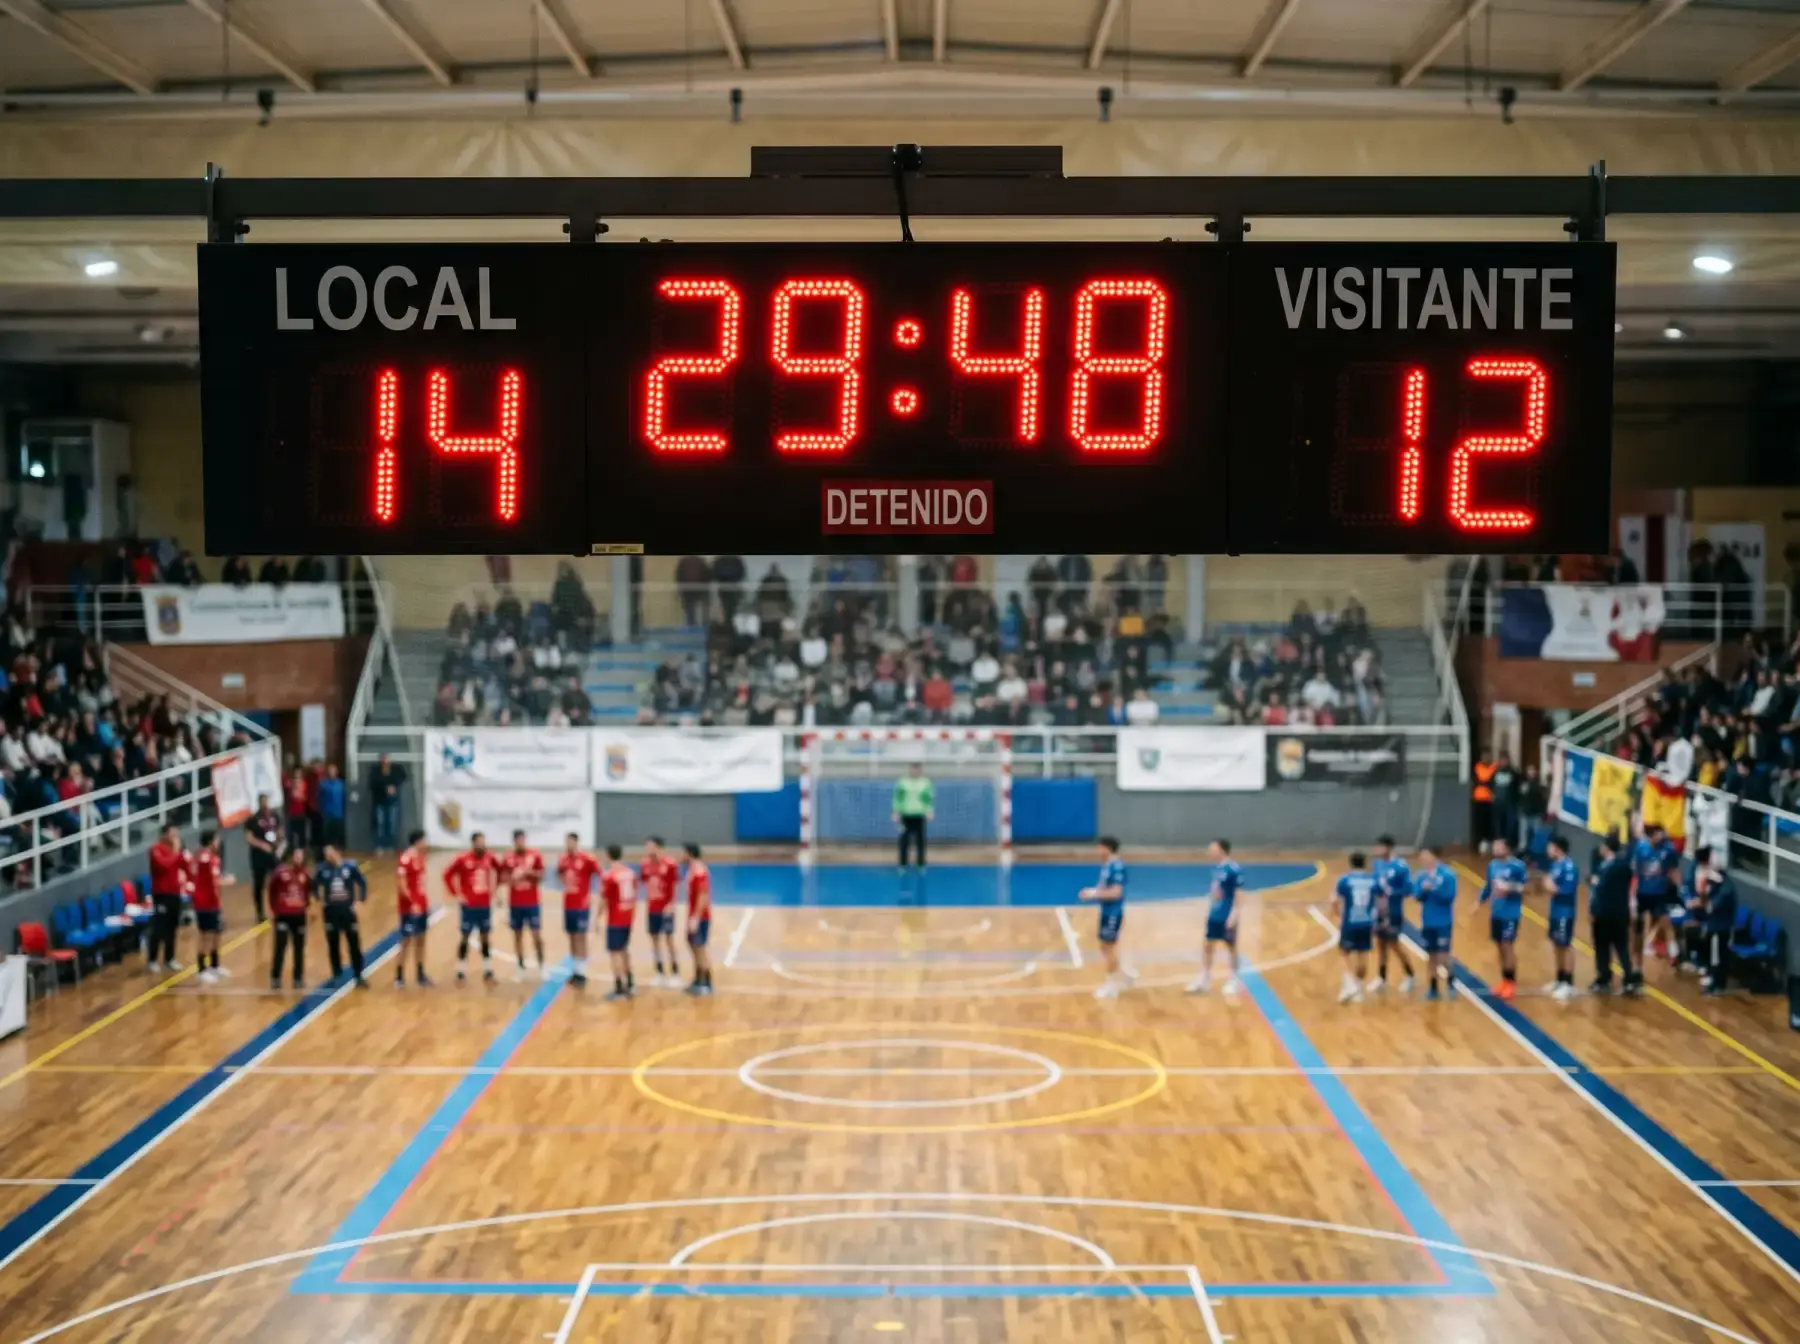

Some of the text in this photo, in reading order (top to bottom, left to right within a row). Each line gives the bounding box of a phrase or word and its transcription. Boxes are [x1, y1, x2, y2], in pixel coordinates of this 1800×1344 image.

[275, 265, 517, 331] LOCAL
[1274, 266, 1573, 330] VISITANTE
[643, 278, 1169, 453] 29:48
[374, 368, 522, 522] 14
[1399, 358, 1548, 531] 12
[827, 488, 988, 526] DETENIDO
